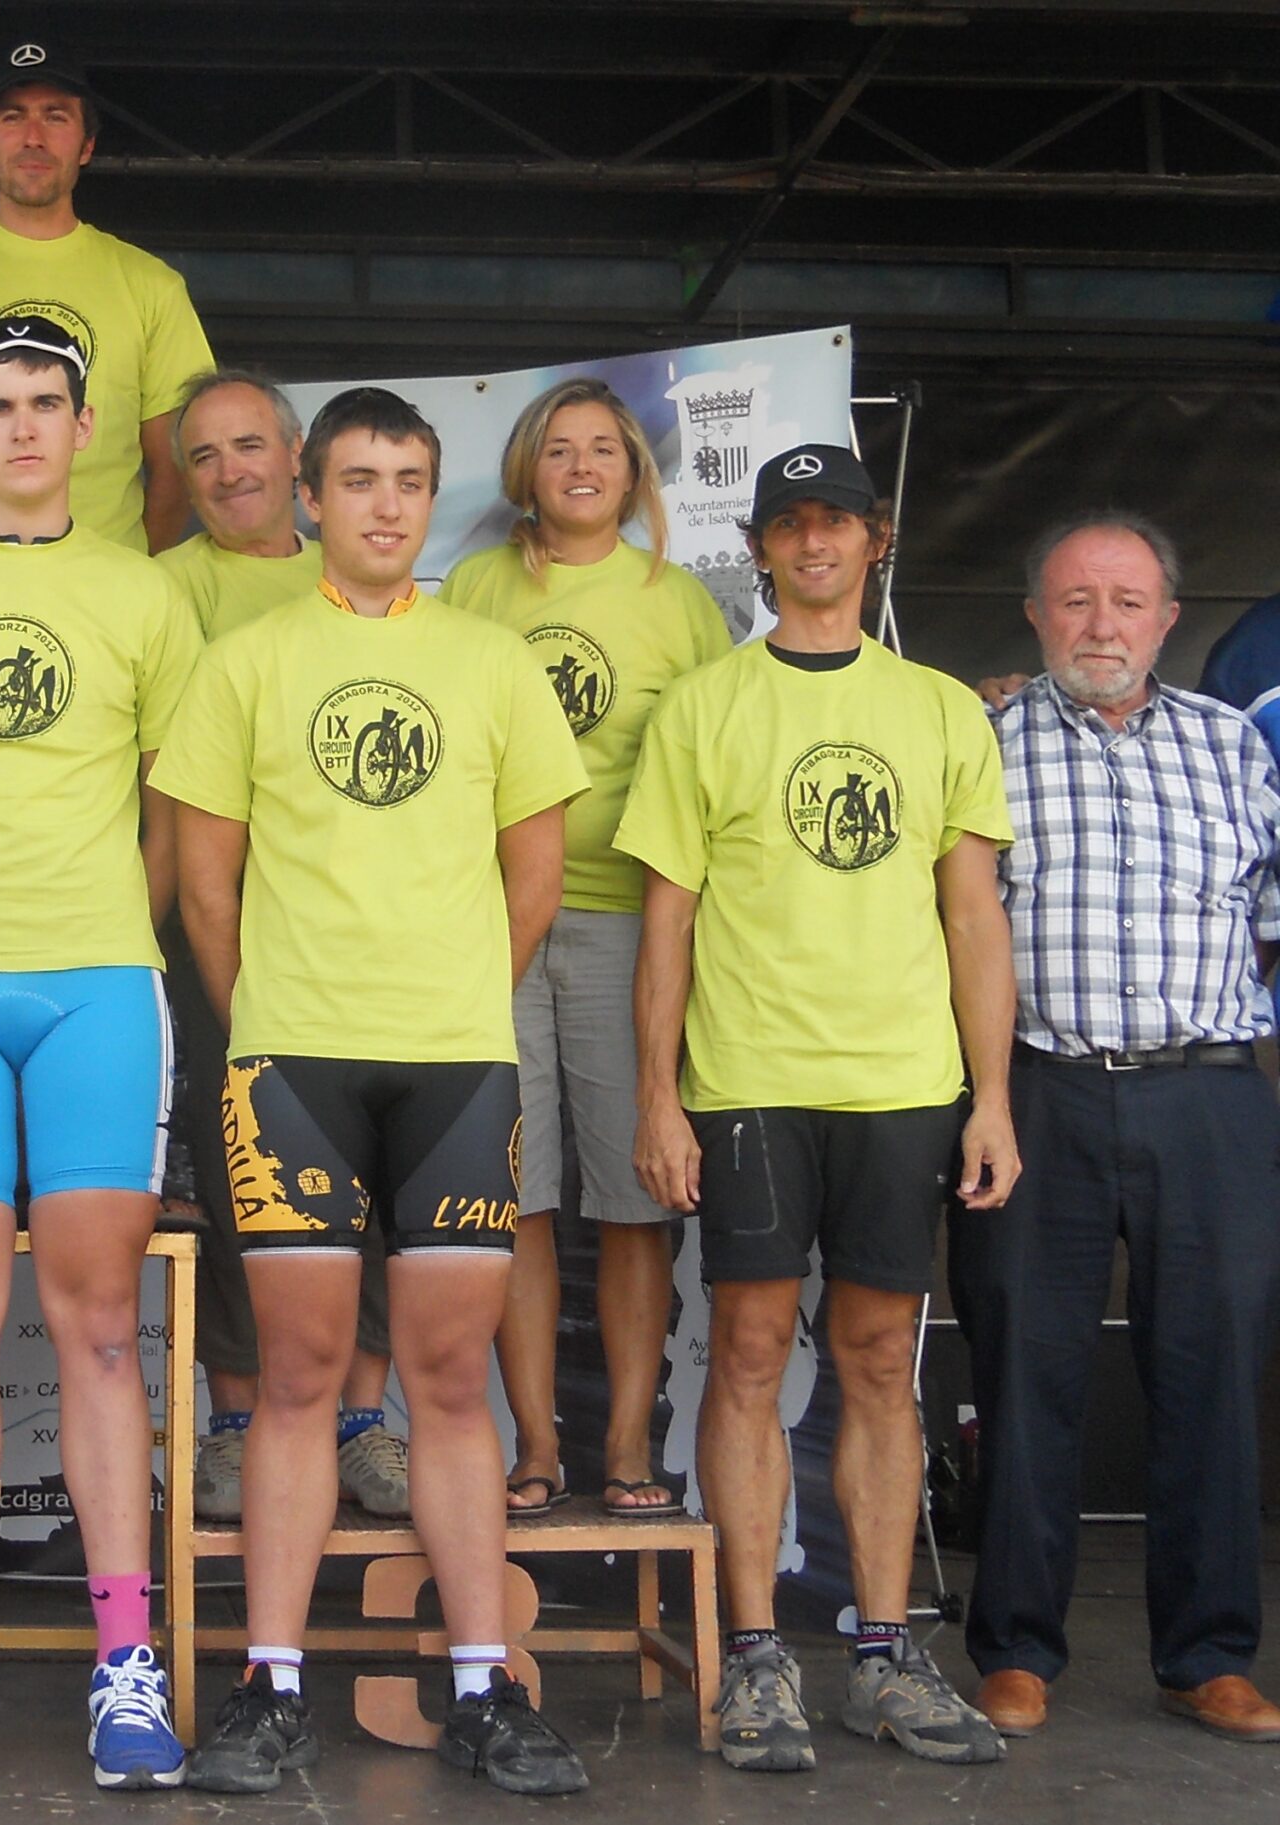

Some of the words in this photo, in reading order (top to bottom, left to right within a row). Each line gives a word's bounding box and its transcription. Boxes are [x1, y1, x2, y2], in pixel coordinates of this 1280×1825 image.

[57, 310, 80, 328] 2012
[677, 498, 754, 514] Ayuntamien
[688, 515, 704, 527] de
[33, 631, 58, 654] 2012
[577, 641, 600, 662] 2012
[328, 685, 389, 710] RIBAGORZA
[396, 693, 422, 713] 2012
[326, 715, 351, 740] IX
[318, 741, 352, 754] CIRCUITO
[325, 755, 350, 769] BTT
[800, 750, 851, 775] RIBAGORZA
[858, 754, 886, 776] 2012
[799, 780, 823, 806] IX
[799, 820, 822, 833] BTT
[433, 1196, 518, 1233] L'AUR
